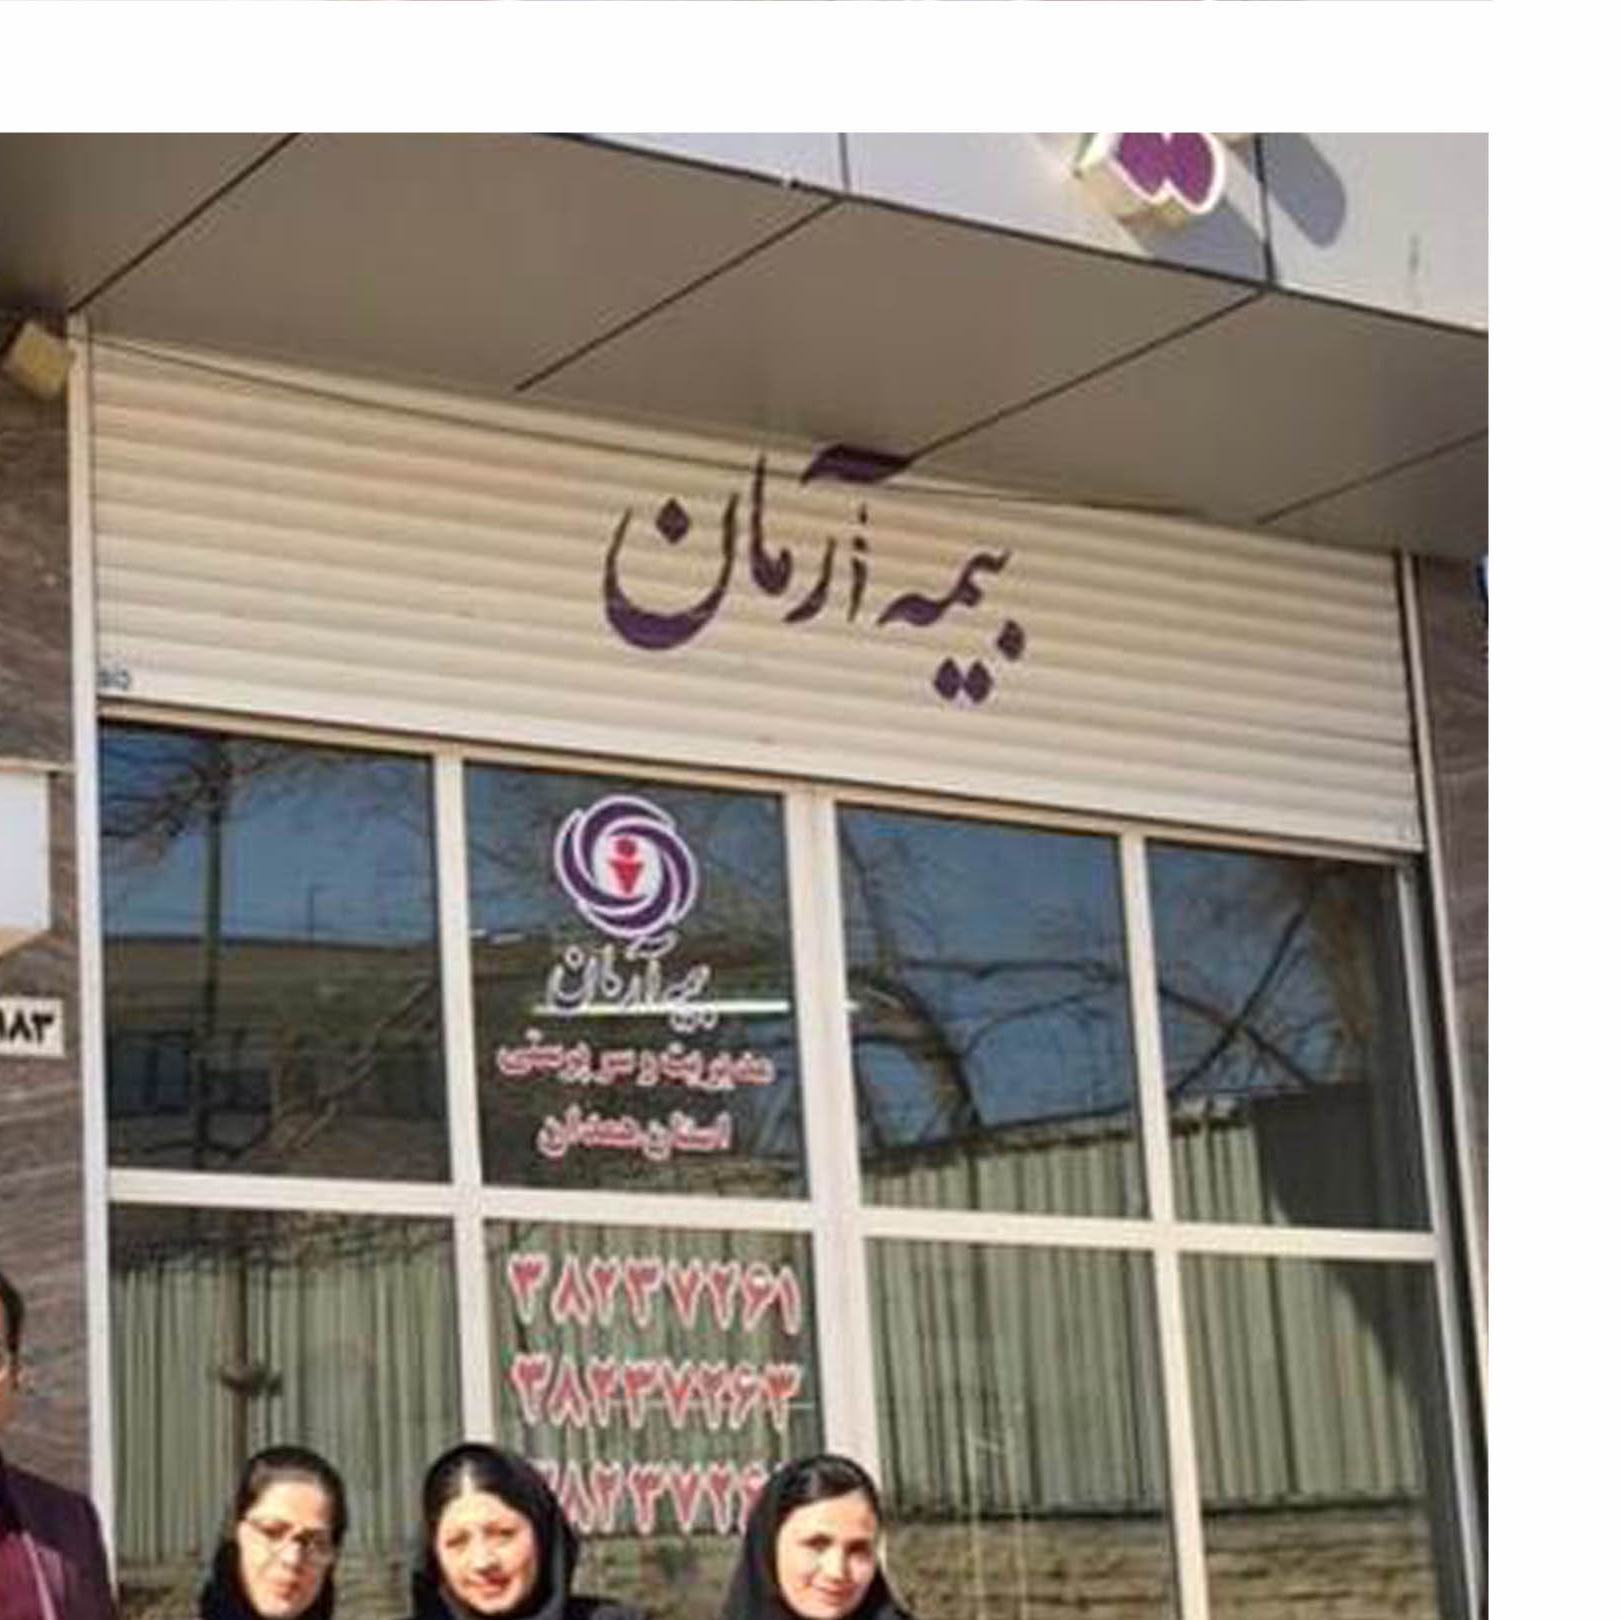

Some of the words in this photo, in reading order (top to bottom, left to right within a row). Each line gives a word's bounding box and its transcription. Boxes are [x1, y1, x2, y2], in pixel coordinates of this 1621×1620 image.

[603, 443, 916, 651] آرمان
[879, 549, 1025, 703] بیمه
[546, 931, 677, 1016] آرمان
[664, 964, 719, 1032] بیمه
[661, 1041, 776, 1091] مدیریت
[536, 1104, 644, 1158] همدان
[643, 1111, 732, 1160] استان
[507, 1253, 801, 1335] ۳۸۲۳۷۲۶۱
[511, 1352, 802, 1431] ۳۸۲۳۷۲۶۳
